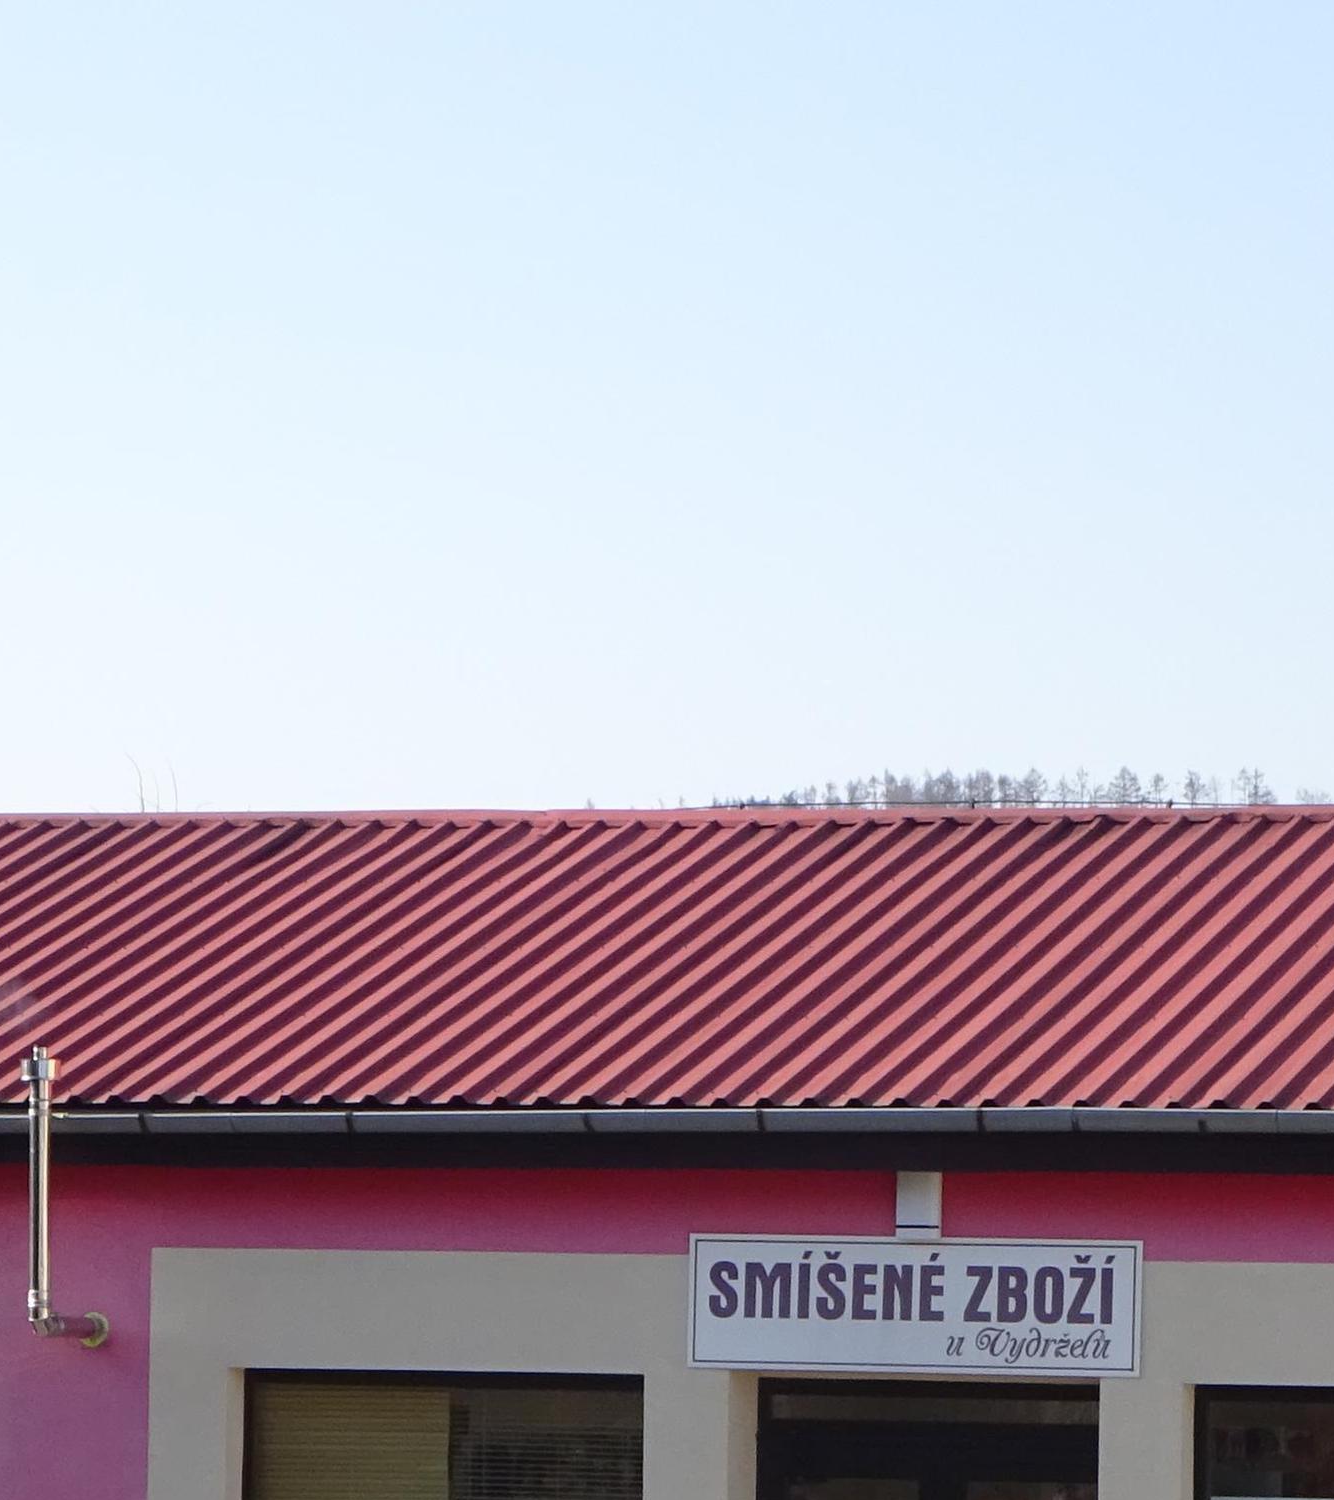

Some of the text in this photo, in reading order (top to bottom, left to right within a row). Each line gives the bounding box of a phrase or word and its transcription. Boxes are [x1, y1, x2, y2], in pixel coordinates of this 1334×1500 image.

[708, 1250, 1114, 1325] SMÍŠENÉ ZBOŽÍ
[946, 1334, 963, 1358] u
